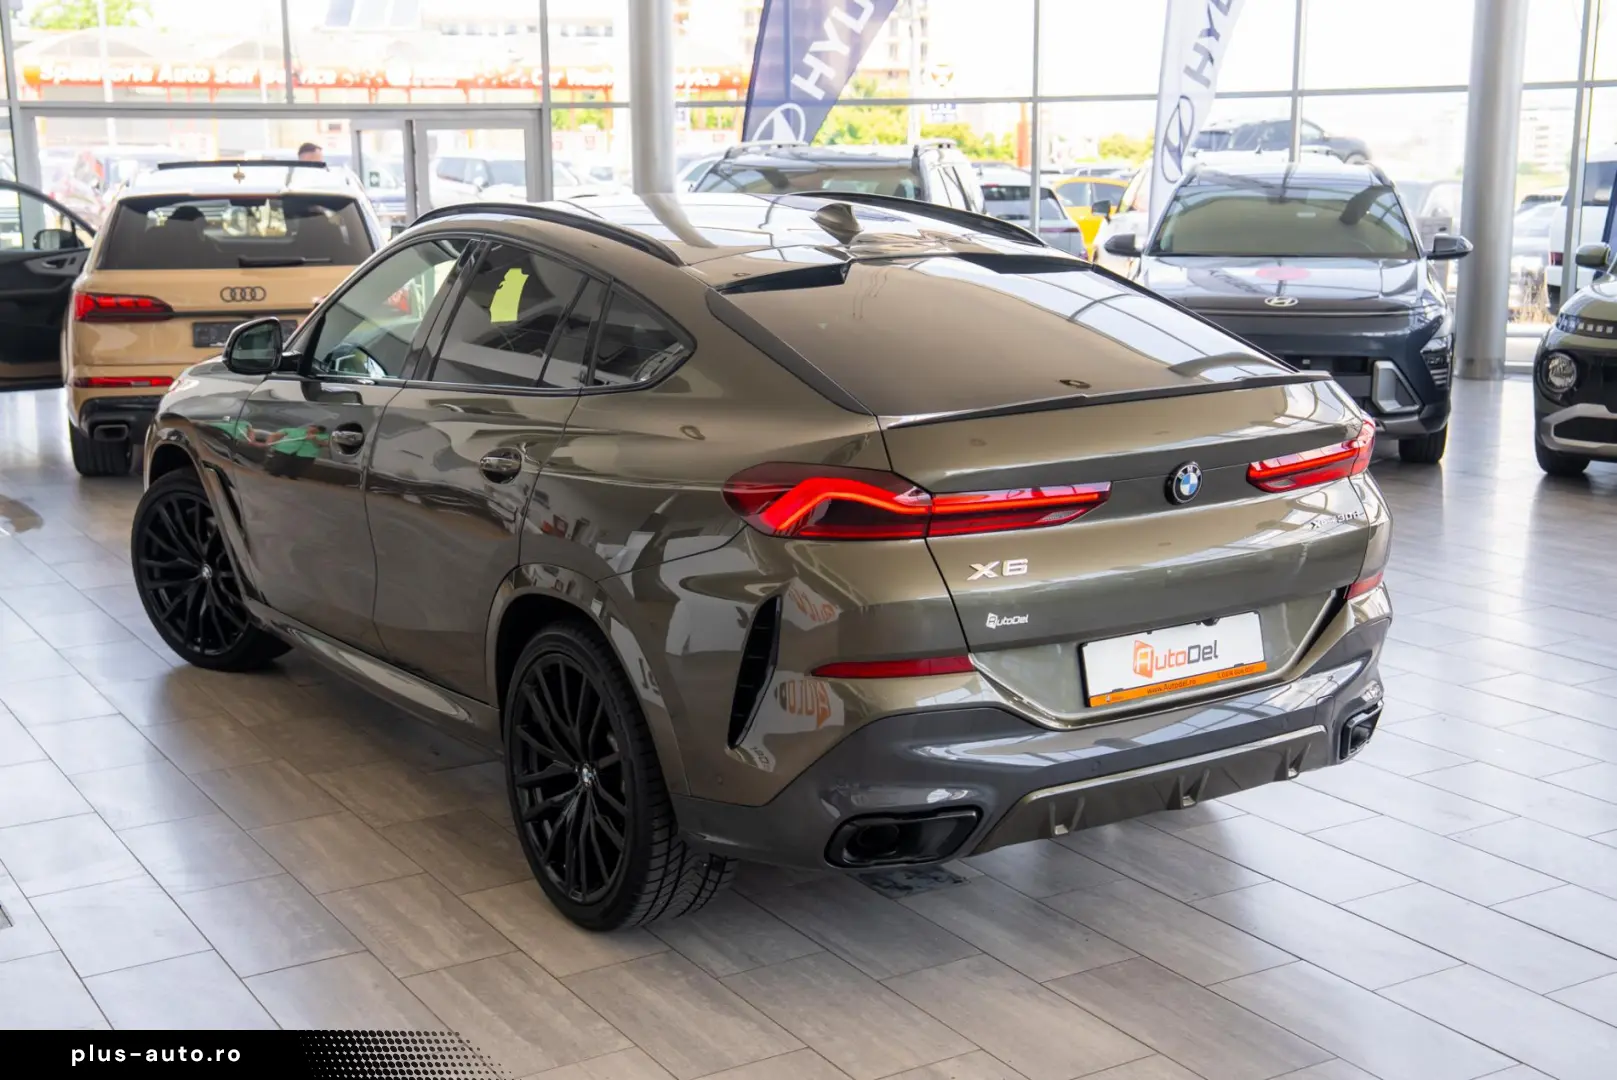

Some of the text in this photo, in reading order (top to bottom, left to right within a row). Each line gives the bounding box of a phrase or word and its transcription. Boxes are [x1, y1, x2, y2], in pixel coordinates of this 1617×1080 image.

[967, 558, 1028, 580] X6
[985, 612, 1029, 629] AutoDel
[1133, 639, 1219, 679] AutoDel
